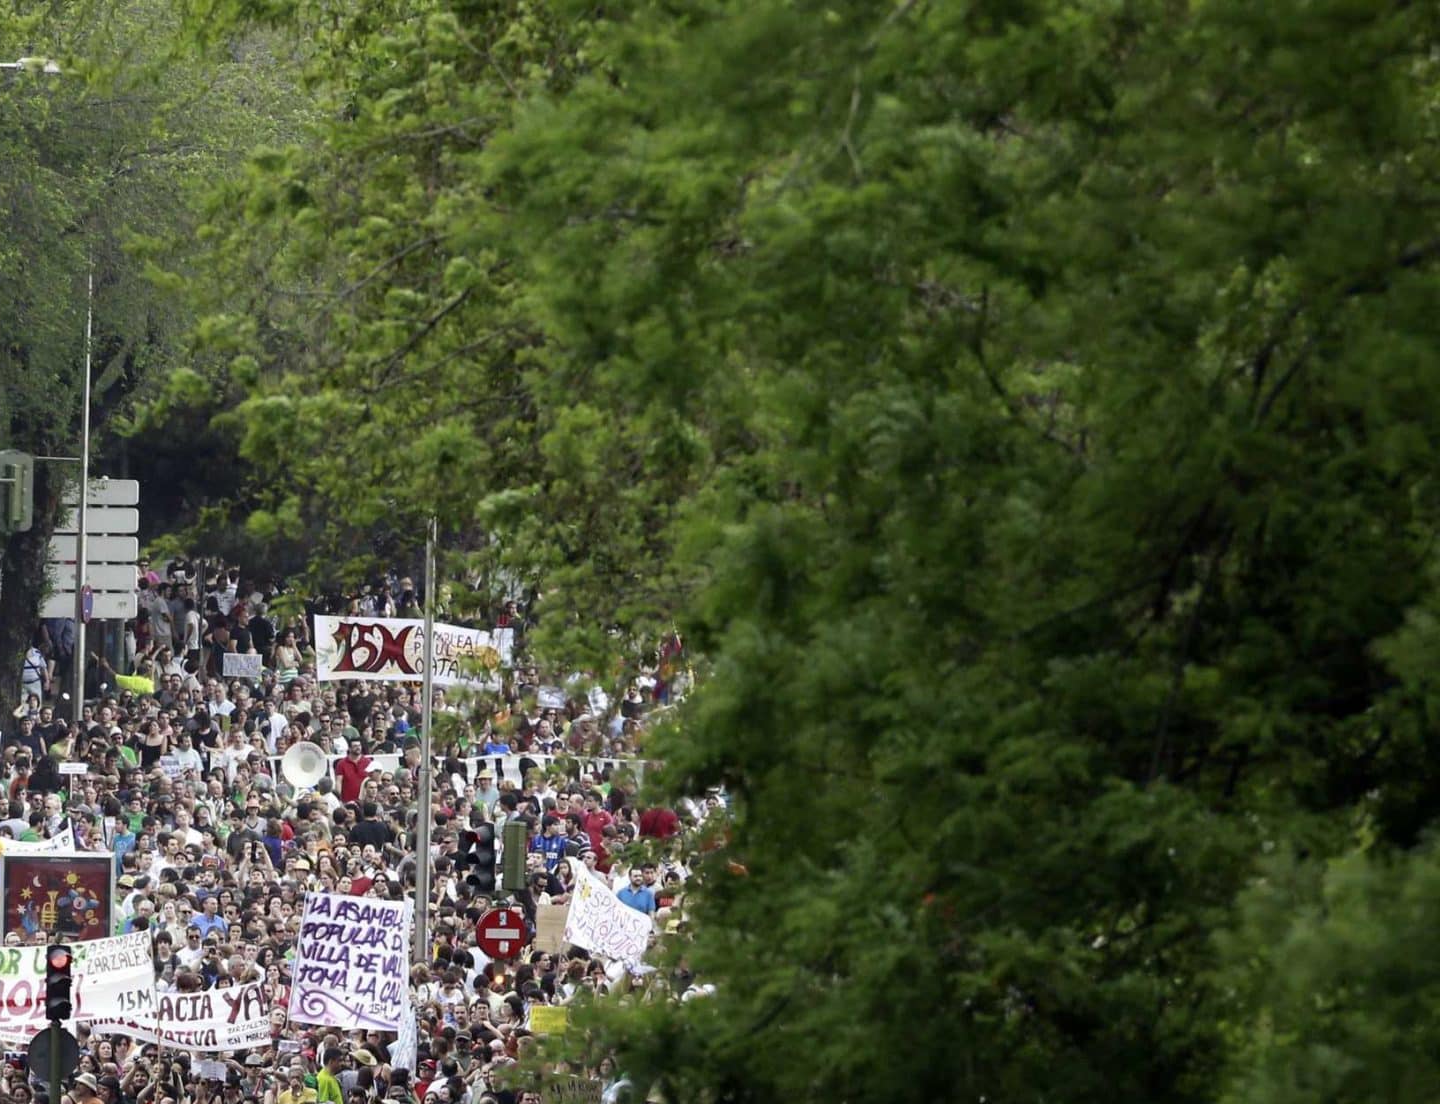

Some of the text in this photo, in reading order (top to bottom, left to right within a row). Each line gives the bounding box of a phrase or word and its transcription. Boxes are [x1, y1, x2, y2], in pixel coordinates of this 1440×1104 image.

[308, 896, 332, 918] LA
[302, 921, 389, 951] POPULAR
[300, 940, 350, 970] VILLA
[353, 953, 381, 973] DE
[116, 988, 153, 1012] 15M
[355, 975, 377, 1002] LA
